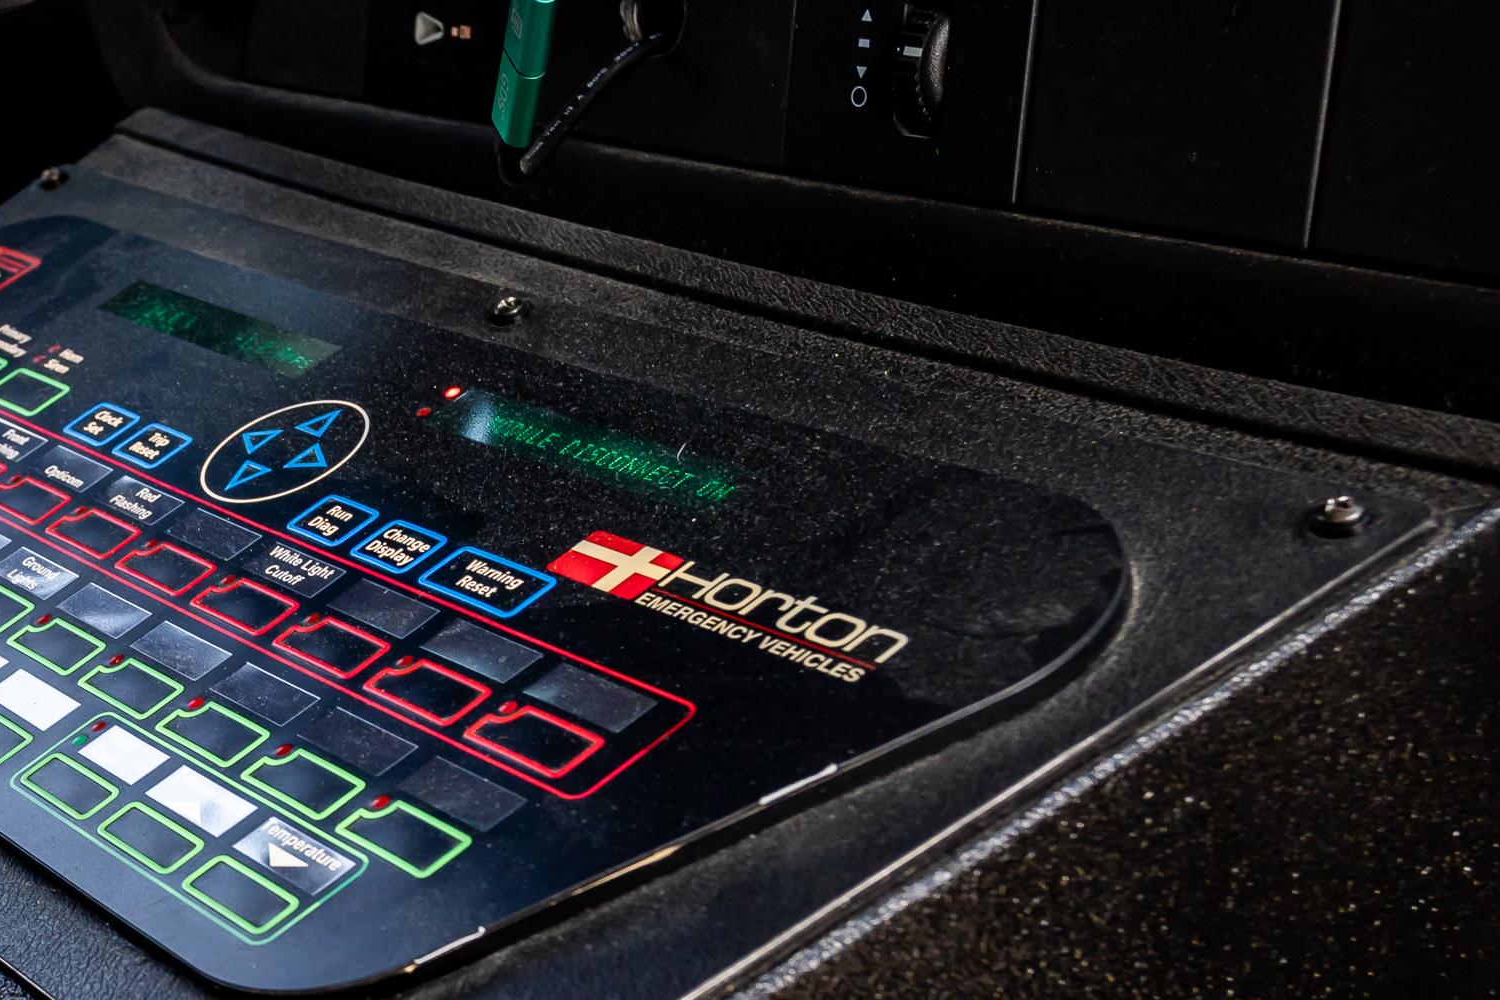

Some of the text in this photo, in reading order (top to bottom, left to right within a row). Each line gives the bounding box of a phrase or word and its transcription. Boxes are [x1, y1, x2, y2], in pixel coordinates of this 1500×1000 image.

[83, 421, 104, 436] Set
[94, 410, 124, 427] Clock
[2, 428, 30, 445] Front
[148, 432, 170, 447] Trip
[128, 441, 160, 460] Reset
[44, 465, 85, 488] Opticom
[109, 494, 153, 520] Flashing
[135, 488, 162, 503] Red
[326, 505, 353, 522] Run
[307, 515, 340, 537] Diag
[383, 527, 432, 553] Change
[269, 545, 335, 580] White Light
[364, 539, 414, 567] Display
[6, 569, 39, 591] Lights
[22, 556, 61, 581] Ground
[264, 564, 306, 587] Cutoff
[465, 558, 525, 591] Warning
[455, 575, 498, 599] Reset
[658, 560, 909, 664] Horton
[634, 592, 866, 683] EMERGENCY VEHICLES
